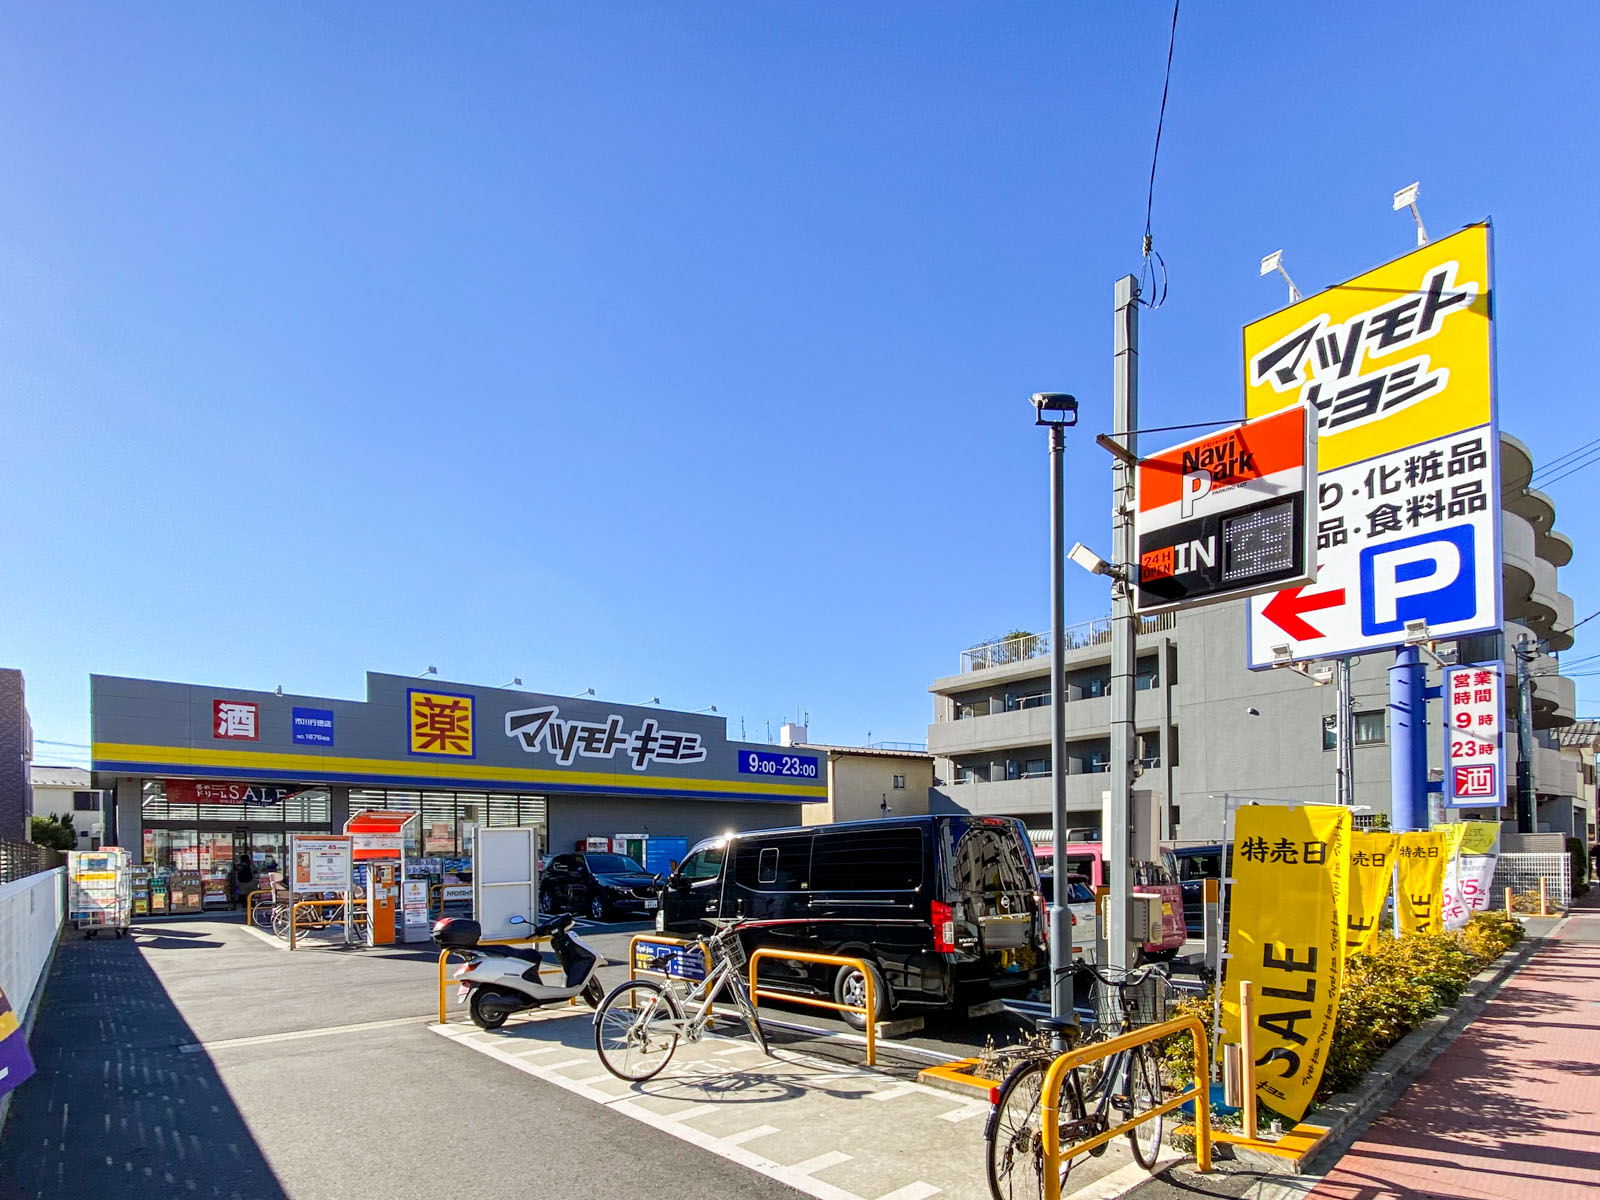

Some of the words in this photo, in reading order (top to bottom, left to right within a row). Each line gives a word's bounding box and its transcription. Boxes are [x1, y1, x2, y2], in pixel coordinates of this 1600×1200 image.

[1257, 269, 1468, 385] マツモト
[1182, 434, 1235, 475] Navi
[1181, 449, 1254, 519] Park
[1143, 564, 1171, 580] OPEN
[1144, 554, 1160, 568] 24
[1162, 549, 1171, 562] H
[1174, 535, 1216, 577] IN
[1372, 540, 1461, 625] P
[1453, 670, 1492, 689] 営業
[1453, 688, 1492, 706] 時間
[218, 702, 256, 738] 酒
[414, 696, 469, 752] 薬
[508, 707, 706, 768] マツモトキヨシ
[228, 784, 288, 803] SALE
[1456, 766, 1491, 795] 酒
[1240, 836, 1328, 866] 特売日
[1350, 850, 1386, 867] 売日
[1400, 846, 1439, 859] 特売日
[1411, 893, 1431, 934] ALE
[1255, 942, 1318, 1079] SALE
